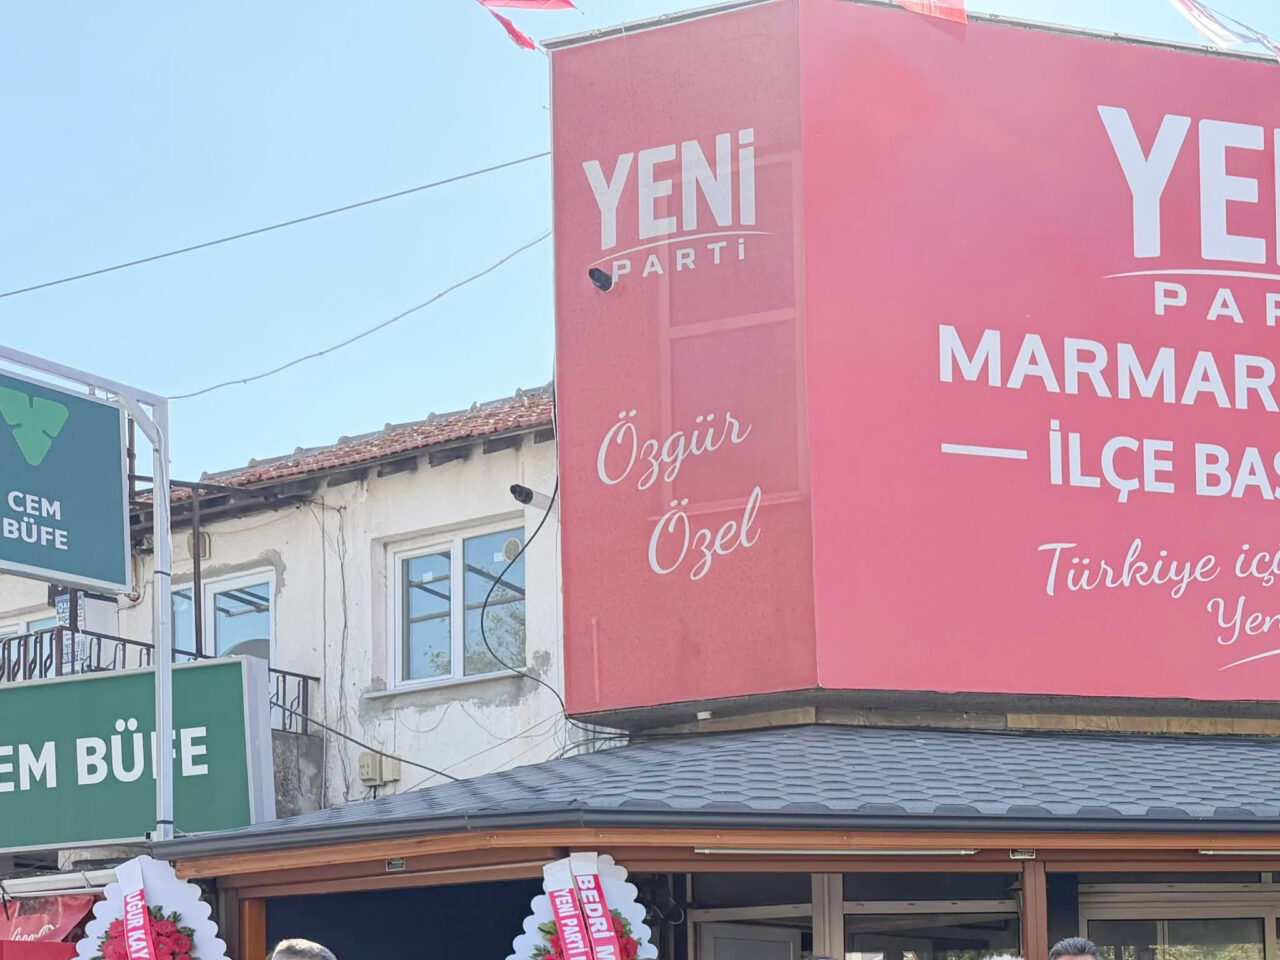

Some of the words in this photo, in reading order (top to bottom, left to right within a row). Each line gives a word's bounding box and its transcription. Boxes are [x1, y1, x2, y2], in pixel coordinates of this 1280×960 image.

[582, 127, 756, 251] YENİ
[612, 238, 745, 283] PARTİ
[597, 409, 752, 491] Özgür
[1048, 418, 1175, 503] İLÇE
[7, 490, 62, 521] CEM
[2, 516, 69, 551] BÜFE
[648, 486, 762, 580] Özel
[1037, 538, 1220, 597] Türkiye
[125, 889, 147, 930] UĞUR
[553, 887, 579, 917] YENİ
[576, 874, 615, 939] BEDRİ
[561, 917, 589, 955] PARTİ
